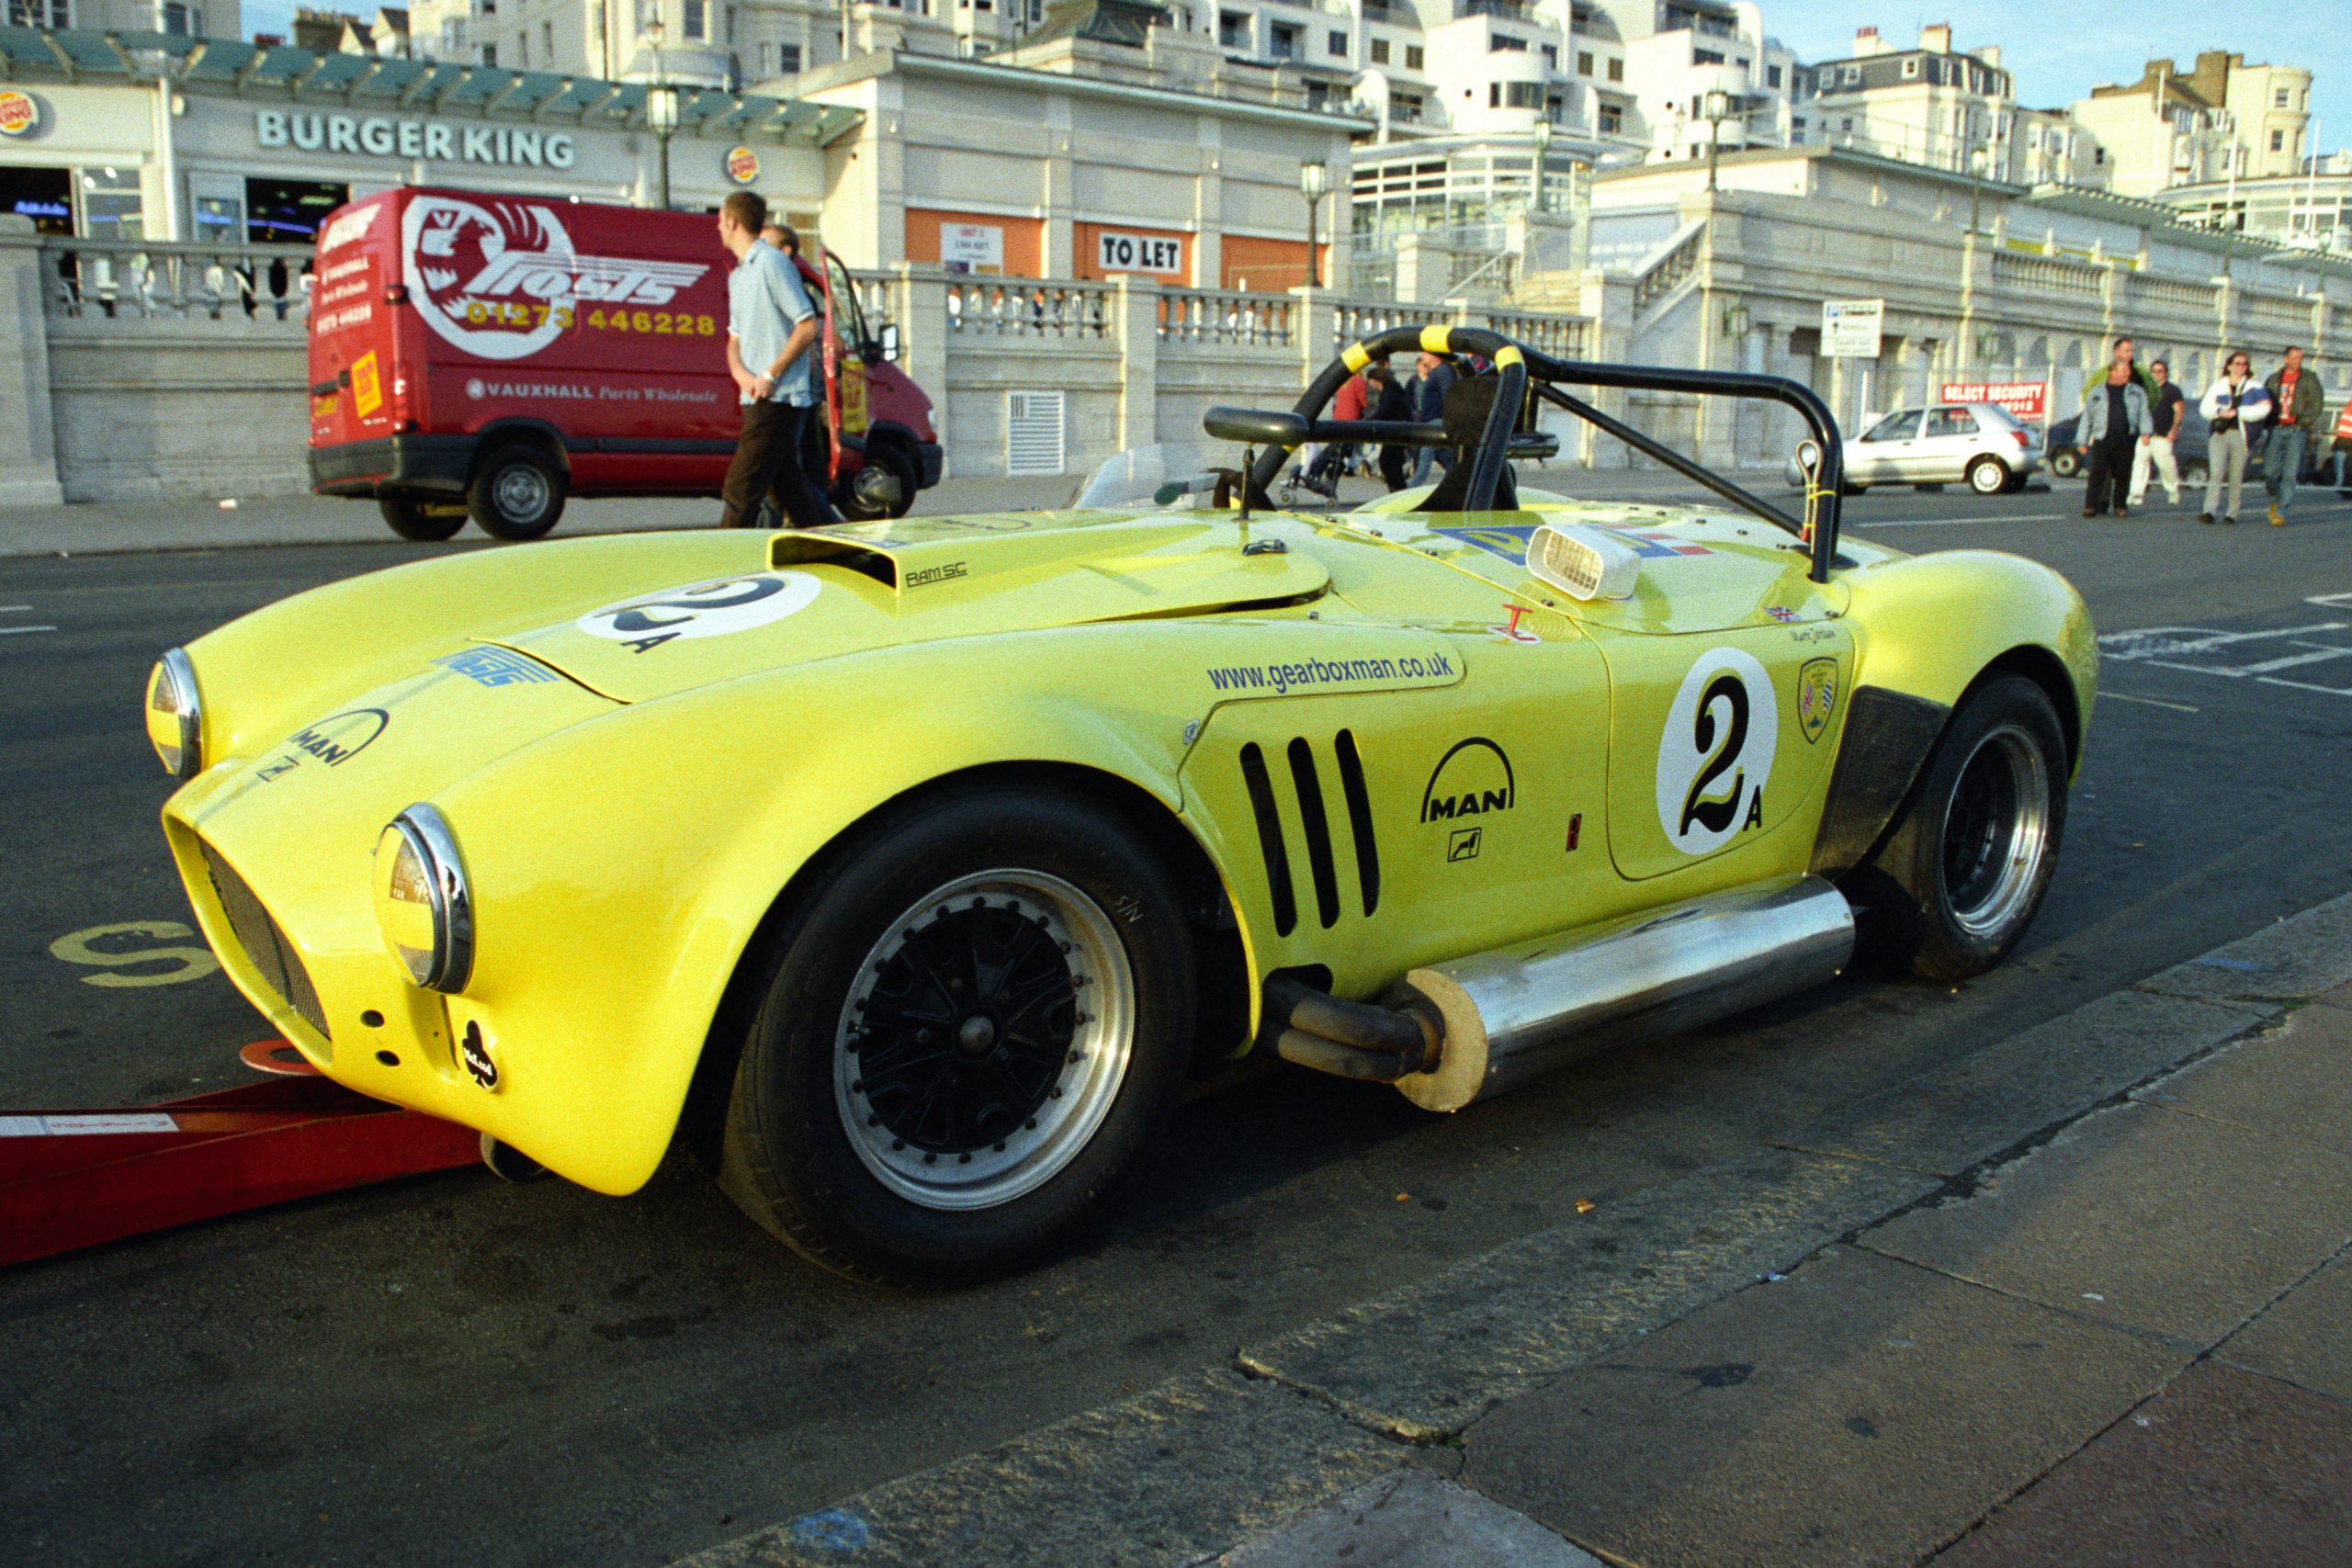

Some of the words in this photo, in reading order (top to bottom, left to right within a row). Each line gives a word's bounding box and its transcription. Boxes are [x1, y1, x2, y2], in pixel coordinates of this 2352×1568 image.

[257, 109, 454, 161] BURGER
[463, 126, 574, 168] KING
[1104, 237, 1133, 265] TO
[1141, 241, 1177, 267] LET
[466, 302, 573, 329] 01273
[588, 309, 716, 336] 446228
[487, 382, 594, 400] VAUXHALL
[598, 386, 640, 401] Parts
[644, 387, 718, 403] Wholesale
[1944, 386, 1984, 400] SELECT
[1987, 384, 2041, 400] SECURITY
[904, 567, 941, 587] RAM
[943, 561, 967, 577] SC
[1207, 651, 1454, 694] www.gearboxman.co.uk
[290, 729, 349, 764] MAN
[1678, 667, 1750, 836] 2
[1430, 788, 1507, 822] MAN
[1743, 784, 1762, 831] A
